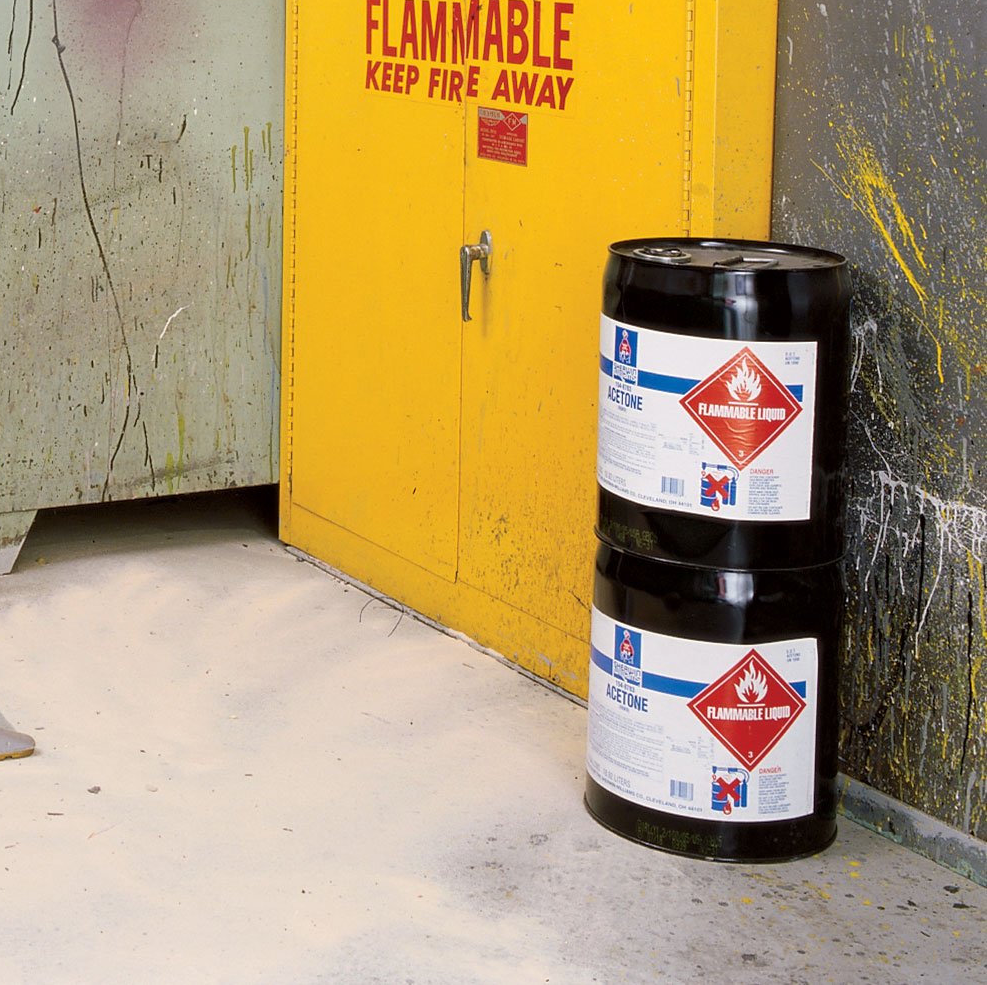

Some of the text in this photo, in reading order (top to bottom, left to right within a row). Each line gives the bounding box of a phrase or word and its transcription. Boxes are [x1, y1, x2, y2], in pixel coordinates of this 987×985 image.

[365, 60, 574, 110] KEEP FIRE AWAY
[608, 385, 643, 411] ACETONE
[698, 403, 786, 422] FLAMMABLE LIQUID
[606, 682, 648, 712] ACETONE
[707, 706, 790, 721] FLAMMABLE LIQUID
